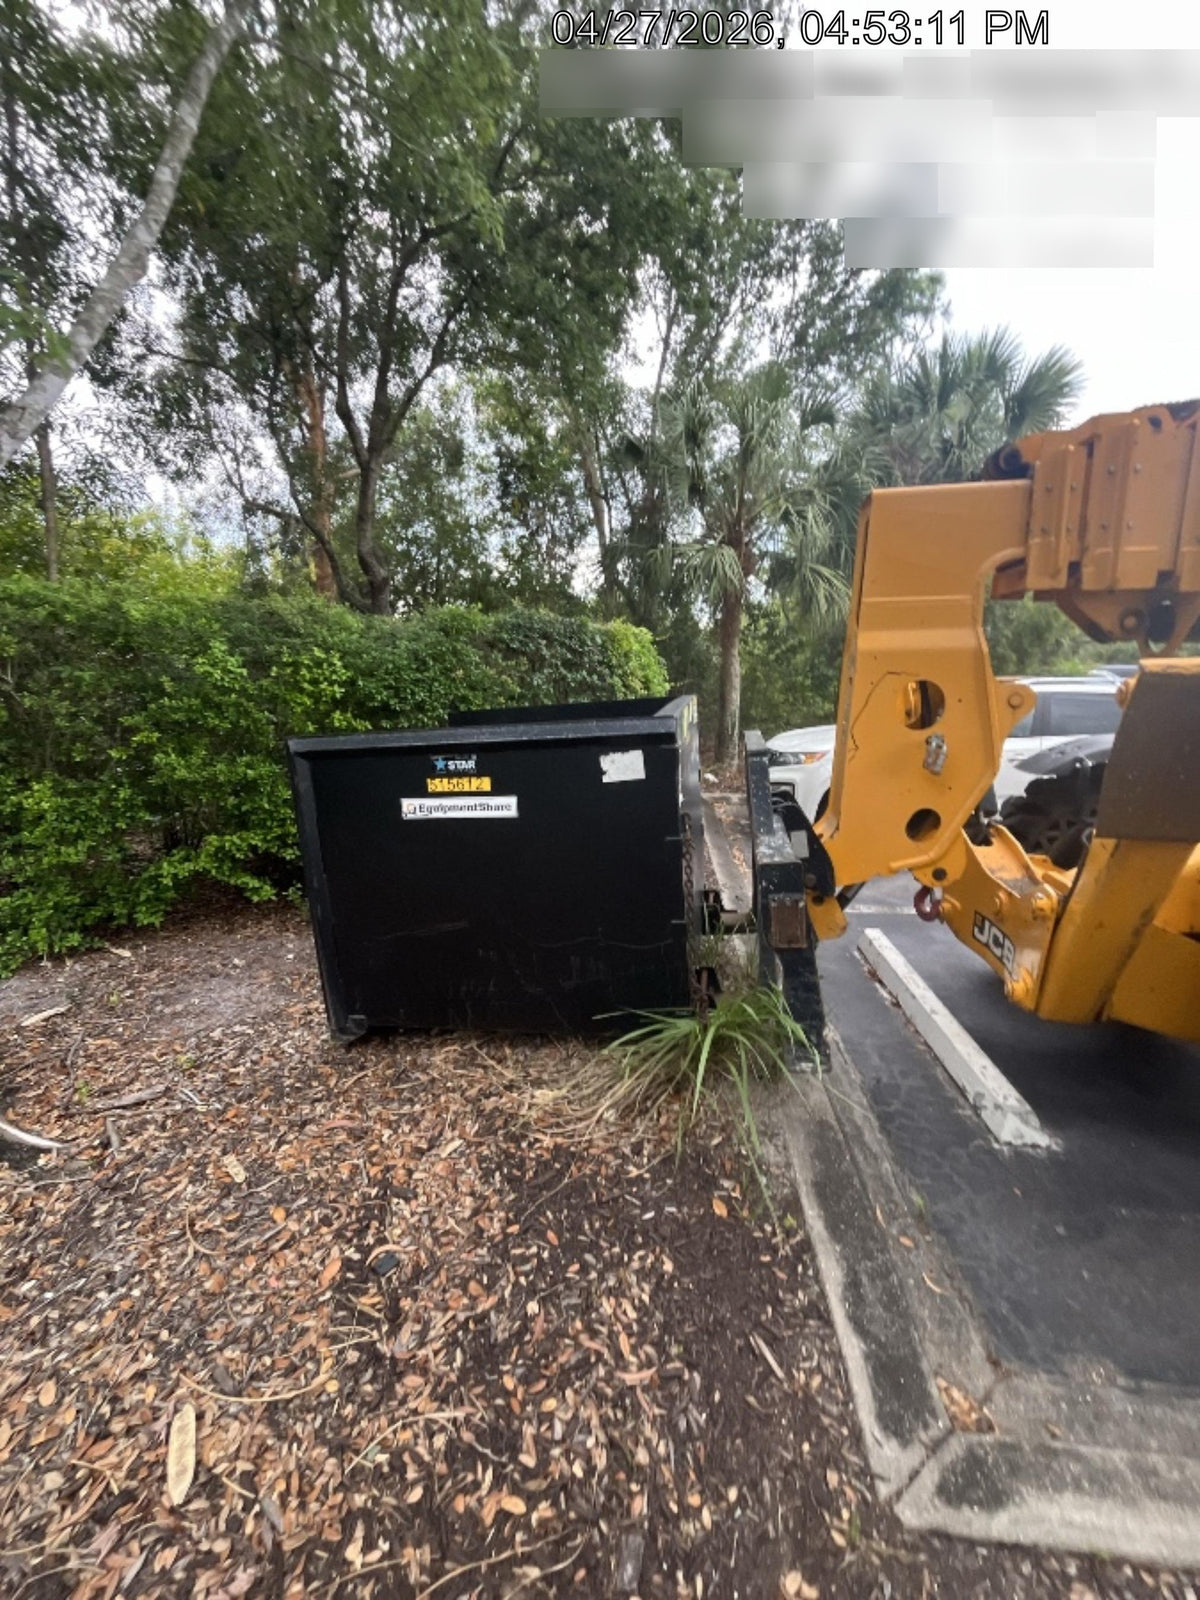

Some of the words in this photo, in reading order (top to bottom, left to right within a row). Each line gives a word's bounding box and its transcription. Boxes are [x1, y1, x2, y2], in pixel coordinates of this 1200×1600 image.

[447, 760, 476, 770] STAR
[418, 803, 512, 816] EquipmentShare
[973, 917, 1015, 975] JCB
